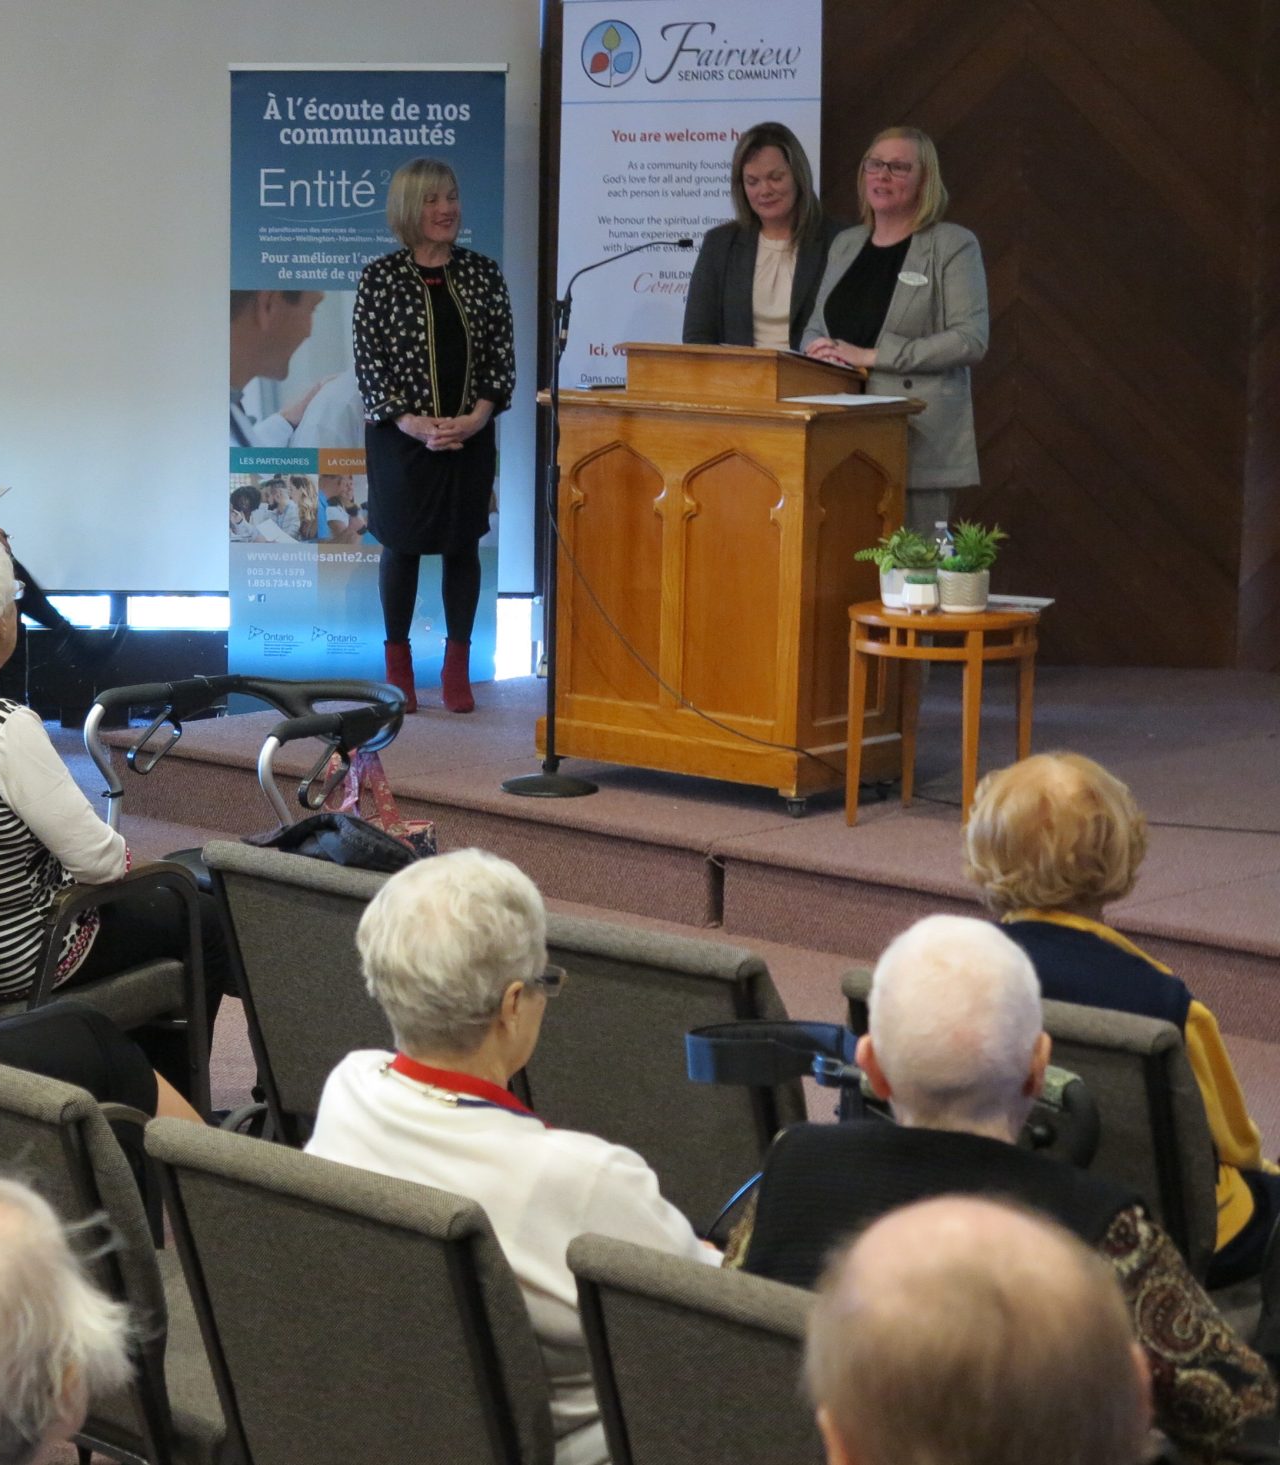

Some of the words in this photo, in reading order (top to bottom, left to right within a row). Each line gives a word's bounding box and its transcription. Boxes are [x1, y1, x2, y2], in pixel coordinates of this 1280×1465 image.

[644, 21, 801, 84] Fairview
[678, 69, 724, 82] SENIORS
[728, 68, 797, 80] COMMUNITY
[263, 92, 282, 120] À
[287, 97, 384, 121] l'écoute
[391, 98, 420, 121] de
[427, 103, 471, 121] nos
[280, 123, 456, 146] communautés
[612, 130, 636, 142] You
[640, 132, 662, 142] are
[665, 128, 727, 142] welcome
[628, 161, 638, 170] As
[639, 162, 645, 170] a
[646, 160, 697, 171] community
[700, 160, 732, 170] founde
[602, 174, 626, 184] God's
[629, 174, 646, 184] love
[648, 174, 660, 184] for
[663, 174, 673, 184] all
[675, 174, 692, 184] and
[695, 174, 731, 185] grounde
[260, 168, 376, 208] Entité
[607, 188, 628, 198] each
[630, 190, 660, 199] person
[662, 189, 669, 198] is
[670, 188, 701, 198] valued
[703, 188, 720, 198] and
[597, 216, 611, 225] We
[613, 215, 645, 225] honour
[647, 215, 661, 225] the
[664, 215, 700, 227] spiritual
[702, 215, 734, 225] dimen
[608, 229, 639, 239] human
[641, 230, 688, 240] experience
[692, 231, 704, 239] an
[603, 243, 622, 253] with
[261, 252, 288, 264] Pour
[291, 251, 351, 264] améliorer
[278, 267, 294, 279] de
[295, 268, 328, 279] santé
[330, 267, 345, 279] de
[347, 270, 363, 282] qu
[659, 271, 693, 279] BUILDIN
[633, 272, 689, 294] Comm
[589, 343, 608, 357] Ici,
[580, 373, 603, 384] Dans
[604, 375, 626, 384] notr
[239, 457, 254, 465] LES
[255, 457, 309, 465] PARTENAIRES
[327, 458, 338, 466] LA
[263, 632, 294, 641] Ontario
[326, 633, 358, 642] Ontario
